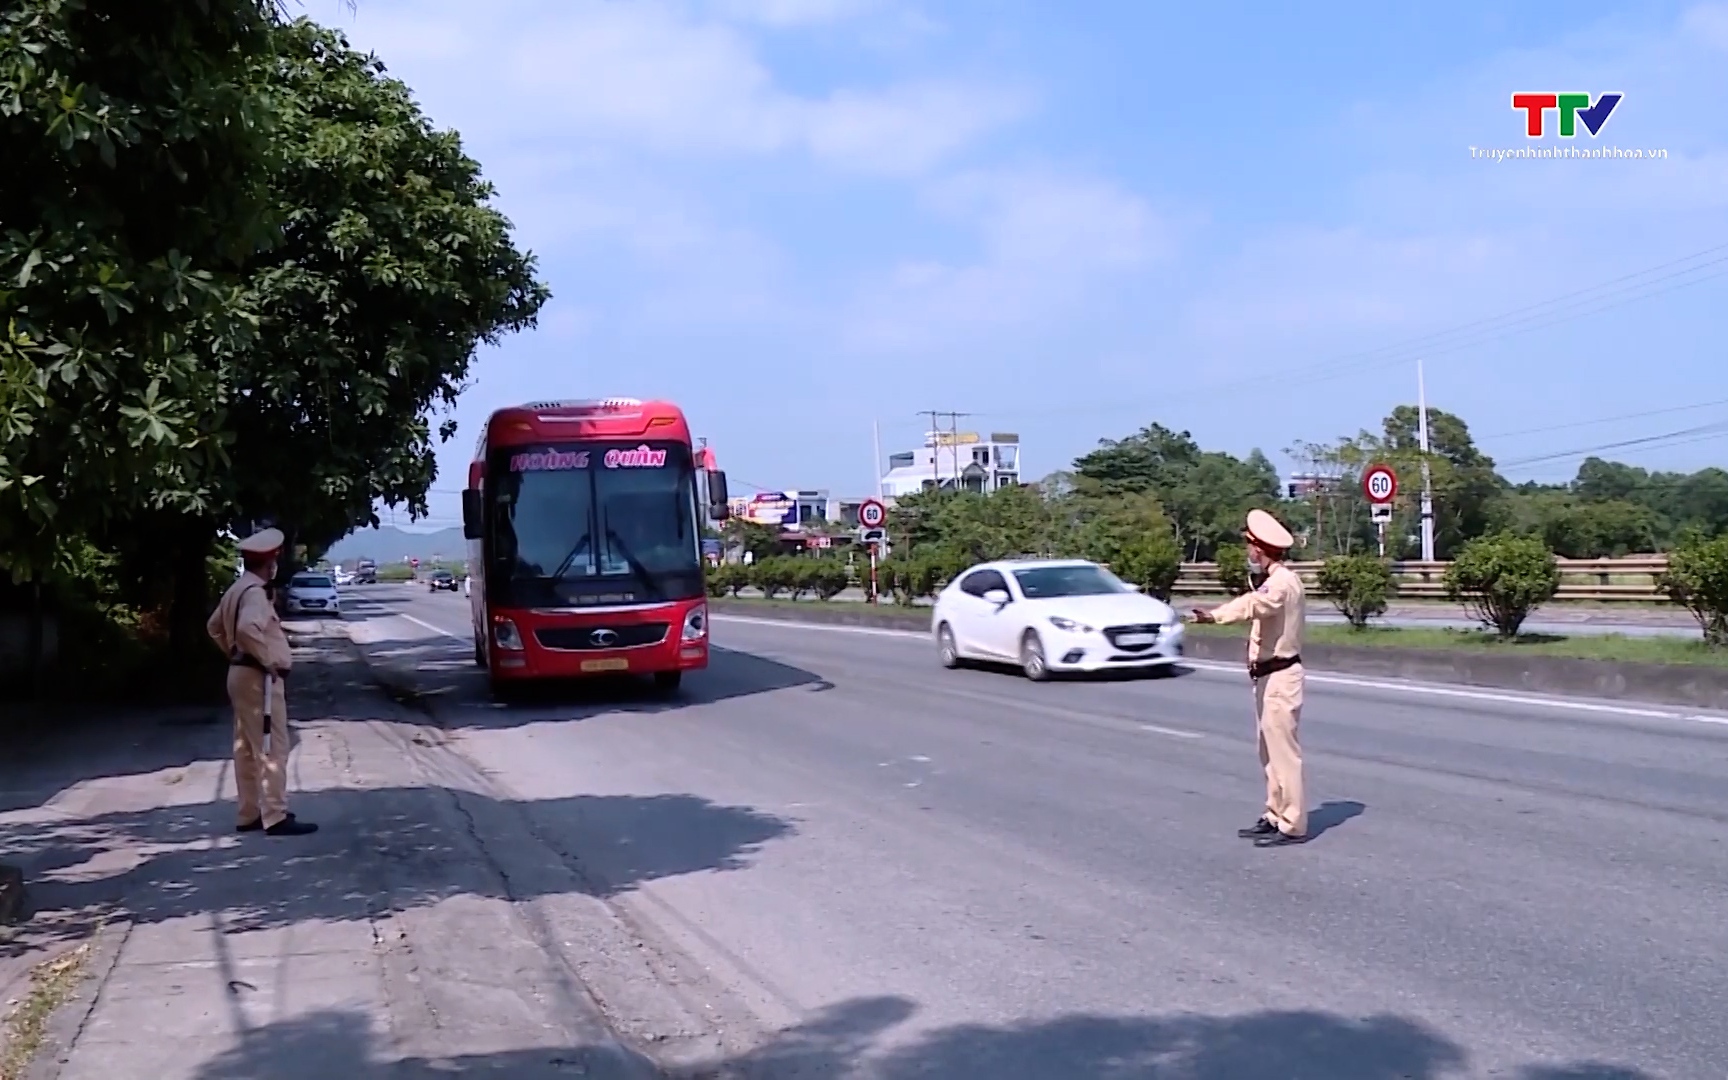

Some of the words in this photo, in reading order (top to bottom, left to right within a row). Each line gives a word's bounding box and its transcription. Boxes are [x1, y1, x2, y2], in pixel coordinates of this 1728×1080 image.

[603, 444, 666, 468] QUÂN
[1372, 476, 1389, 494] 60
[866, 508, 878, 520] 60
